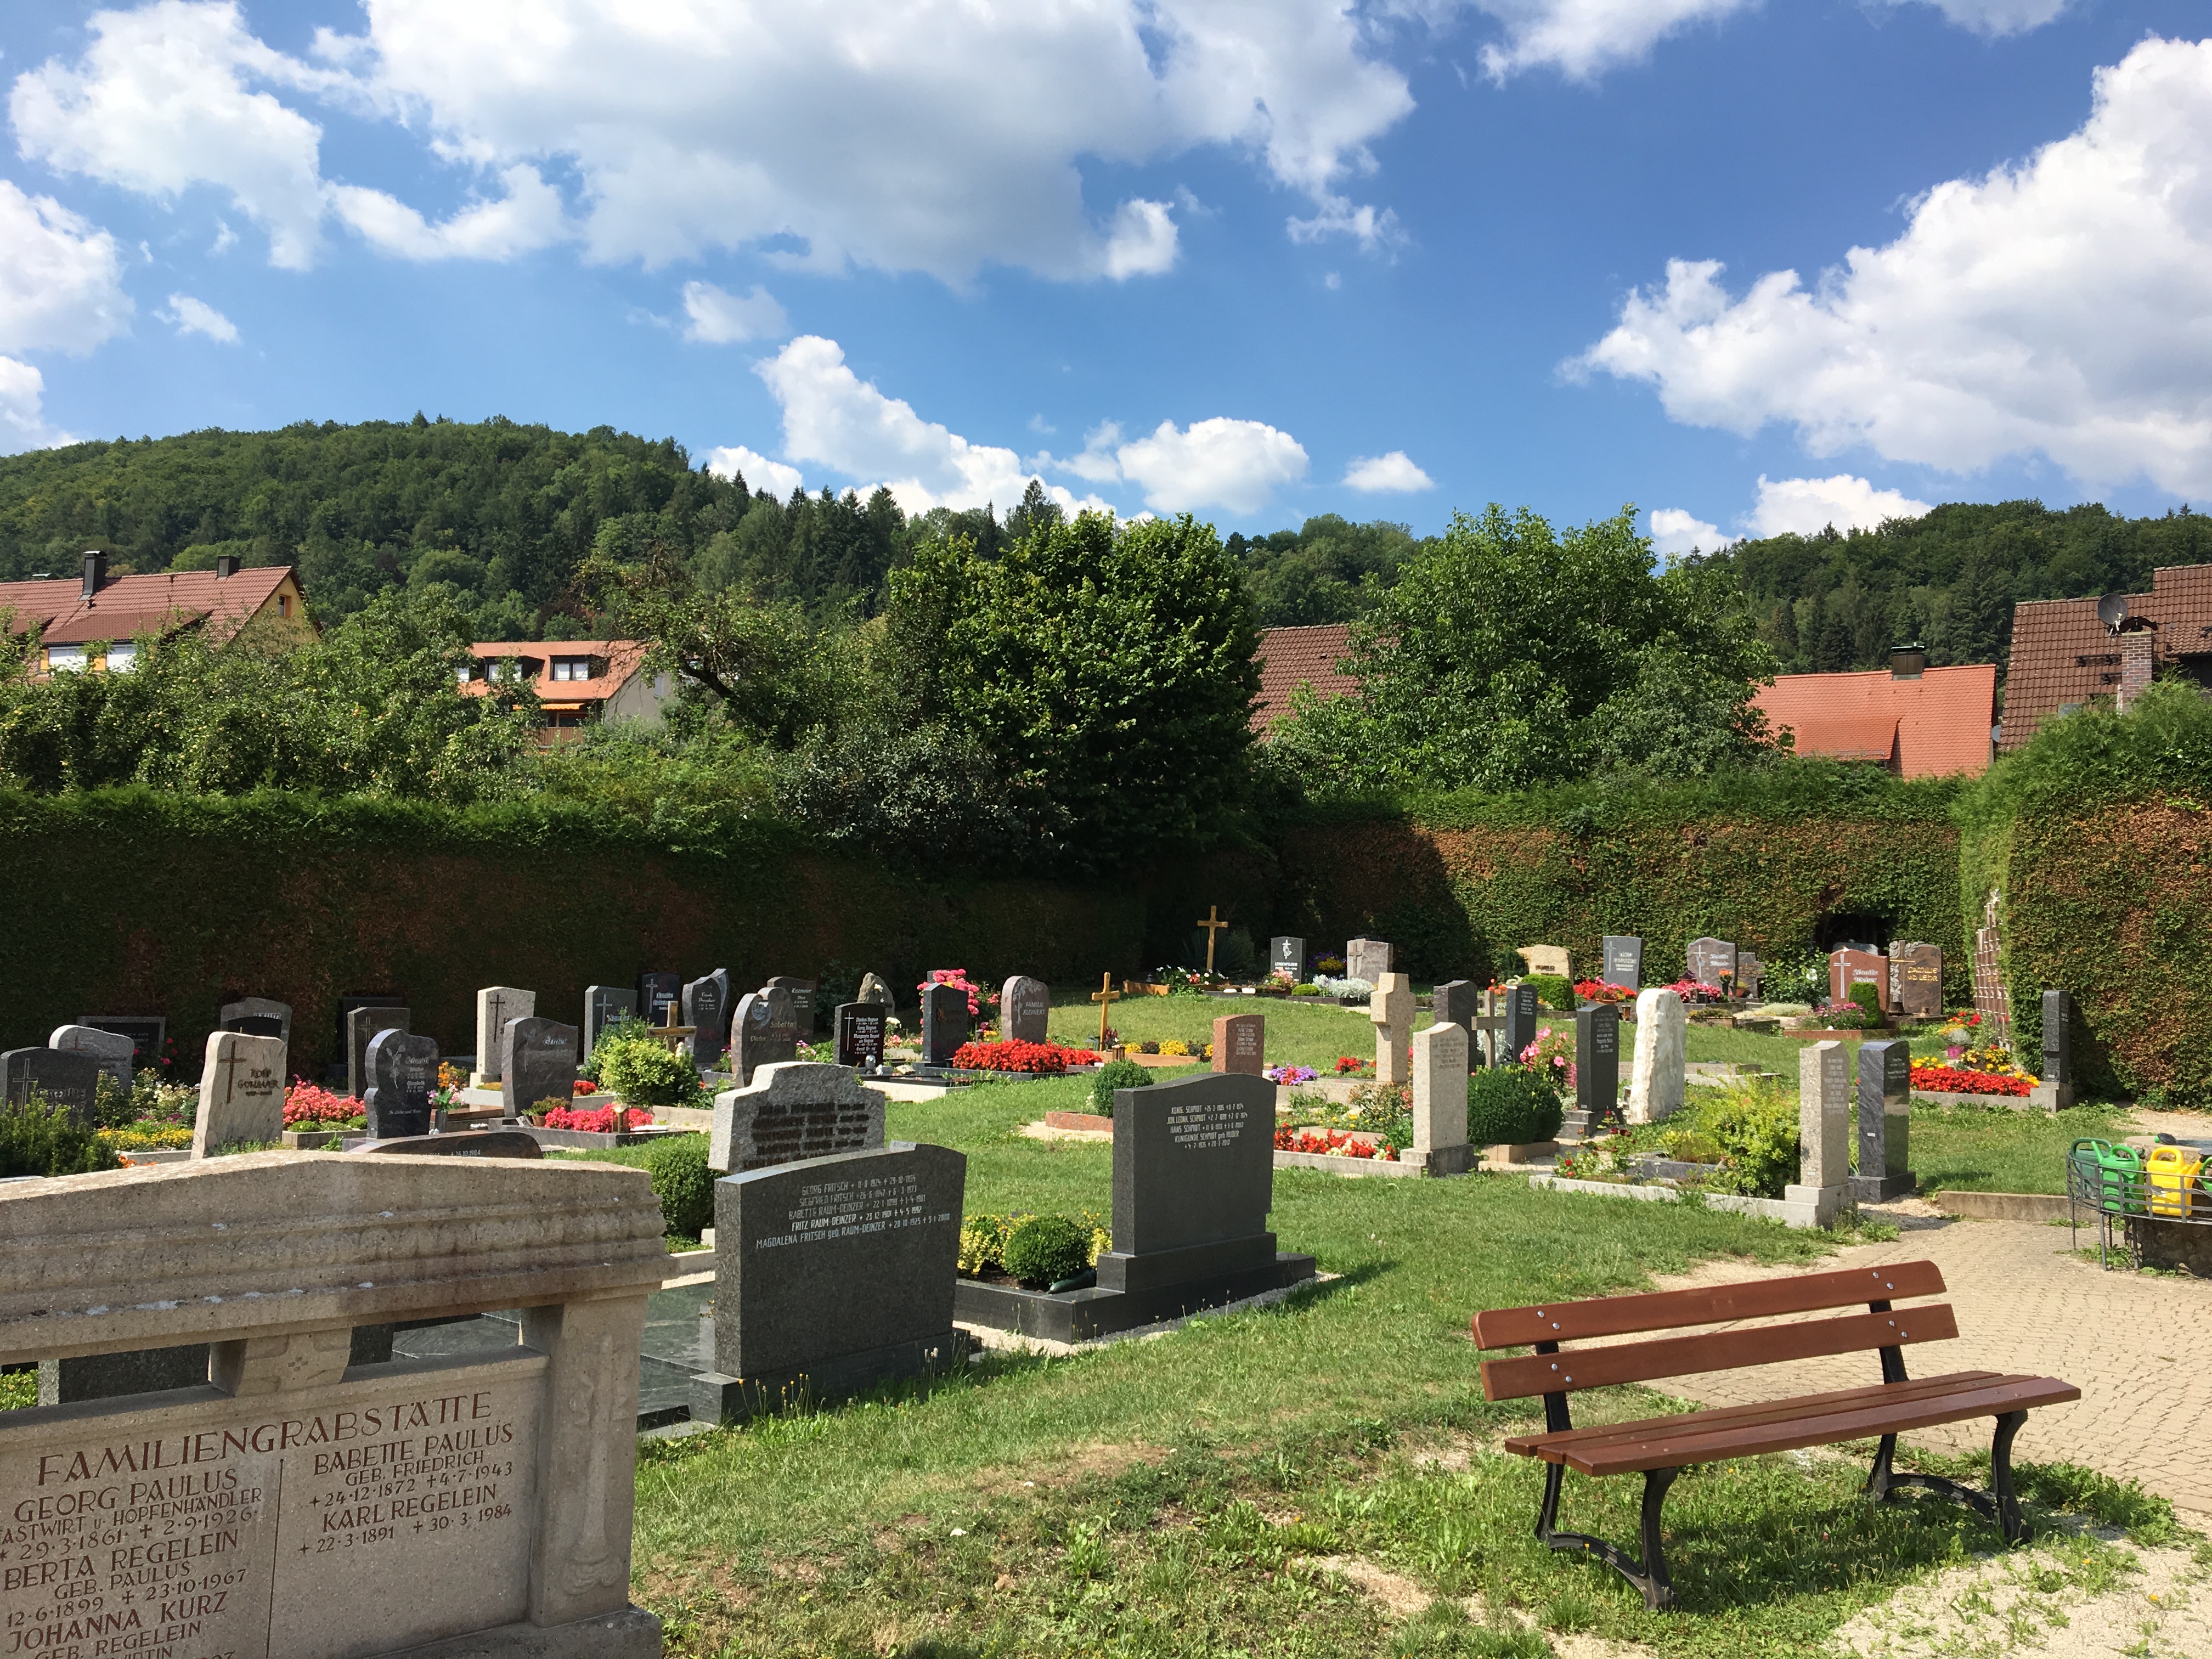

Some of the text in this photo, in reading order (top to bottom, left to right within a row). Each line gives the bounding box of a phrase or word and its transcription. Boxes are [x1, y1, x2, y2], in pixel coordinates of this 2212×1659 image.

[1170, 1125, 1182, 1133] HANS
[799, 1195, 828, 1207] SIEGFRIED
[830, 1192, 854, 1203] FRITSCH
[802, 1184, 821, 1195] GEORG
[824, 1182, 848, 1193] FRITSCH
[789, 1207, 816, 1220] BABETTE
[792, 1221, 808, 1231] FRITZ
[756, 1234, 797, 1249] MAGDALENA
[800, 1230, 825, 1243] FRITSCH
[828, 1229, 840, 1239] geb.
[38, 1391, 491, 1486] FAMILIENGRABSTÄTTE
[314, 1423, 513, 1476] BABETTE PAULUS
[345, 1450, 484, 1486] GEB. FRIEDRICH
[14, 1468, 237, 1522] GEORG PAULUS
[323, 1483, 496, 1533] KARL REGELEIN
[0, 1516, 86, 1545] ASTWIRT
[112, 1487, 262, 1526] HOPFENHÄNDLER
[4, 1529, 239, 1591] BERTA REGELEIN
[55, 1560, 190, 1599] GEB. PAULUS
[5, 1591, 228, 1654] JOHANNA KURZ
[95, 1620, 201, 1656] REGELEIN
